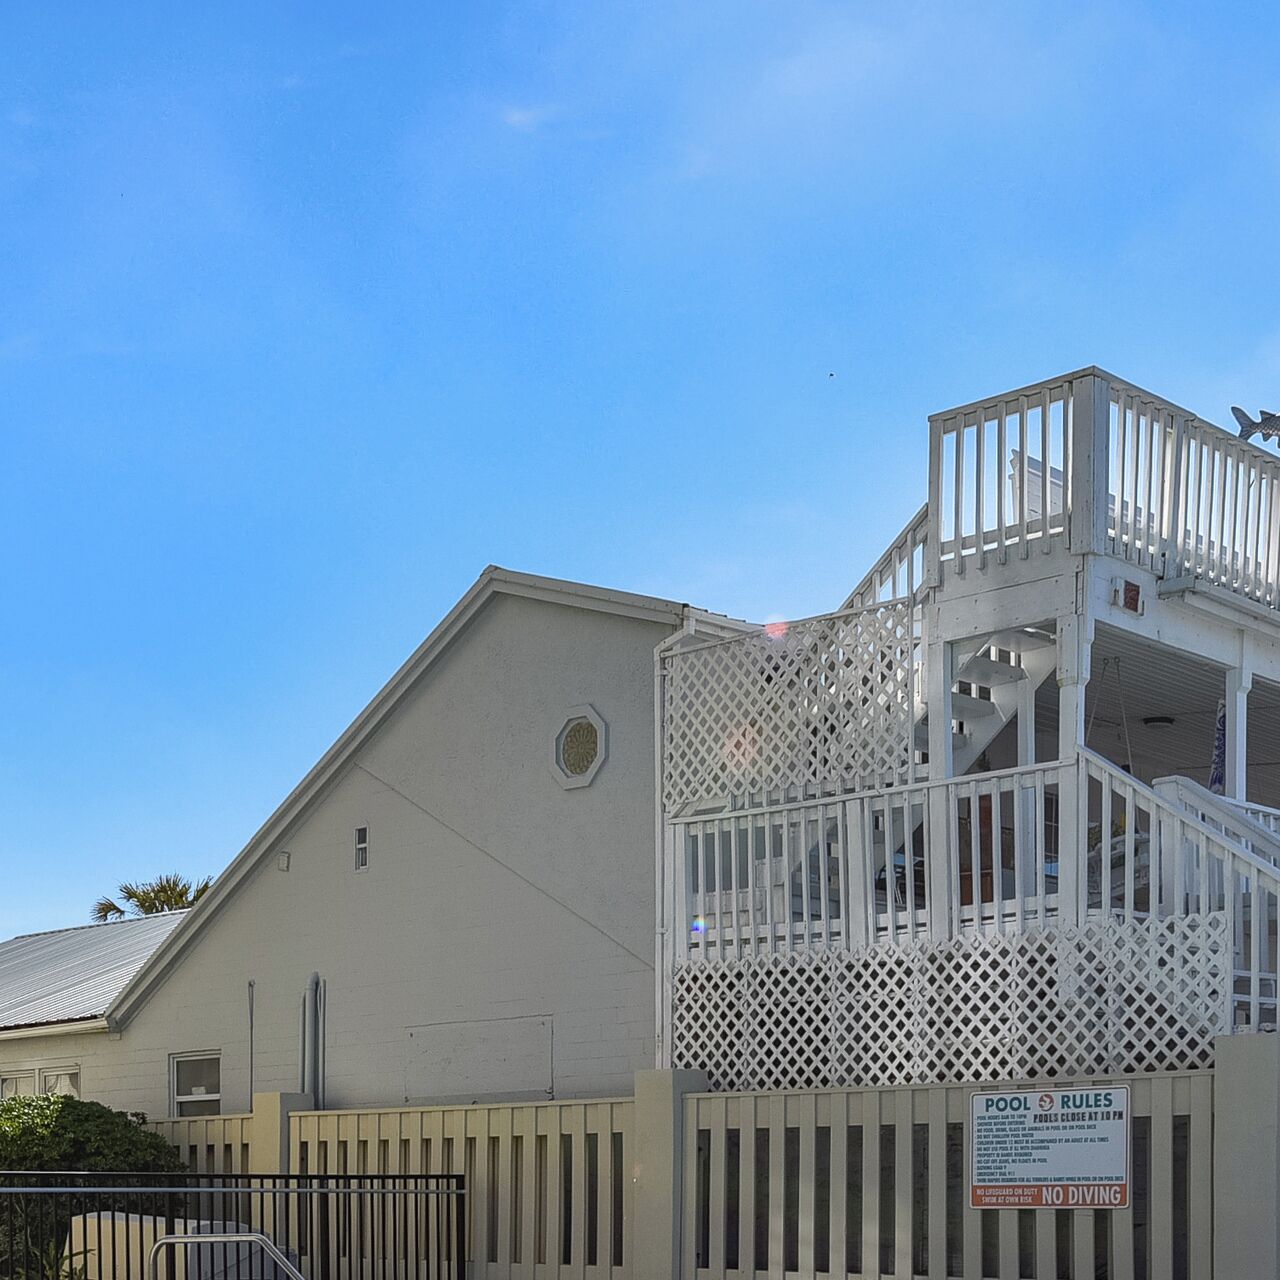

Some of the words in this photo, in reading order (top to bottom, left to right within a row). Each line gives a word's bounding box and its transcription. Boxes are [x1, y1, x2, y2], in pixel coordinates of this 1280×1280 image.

[985, 1096, 1031, 1112] POOL
[1061, 1092, 1113, 1109] RULES
[1033, 1113, 1058, 1123] POOLS
[1061, 1112, 1086, 1122] CLOSE
[1088, 1111, 1098, 1121] AT
[1101, 1110, 1110, 1120] 10
[1112, 1110, 1124, 1120] PM
[1041, 1186, 1064, 1204] NO
[1069, 1185, 1121, 1204] DIVING
